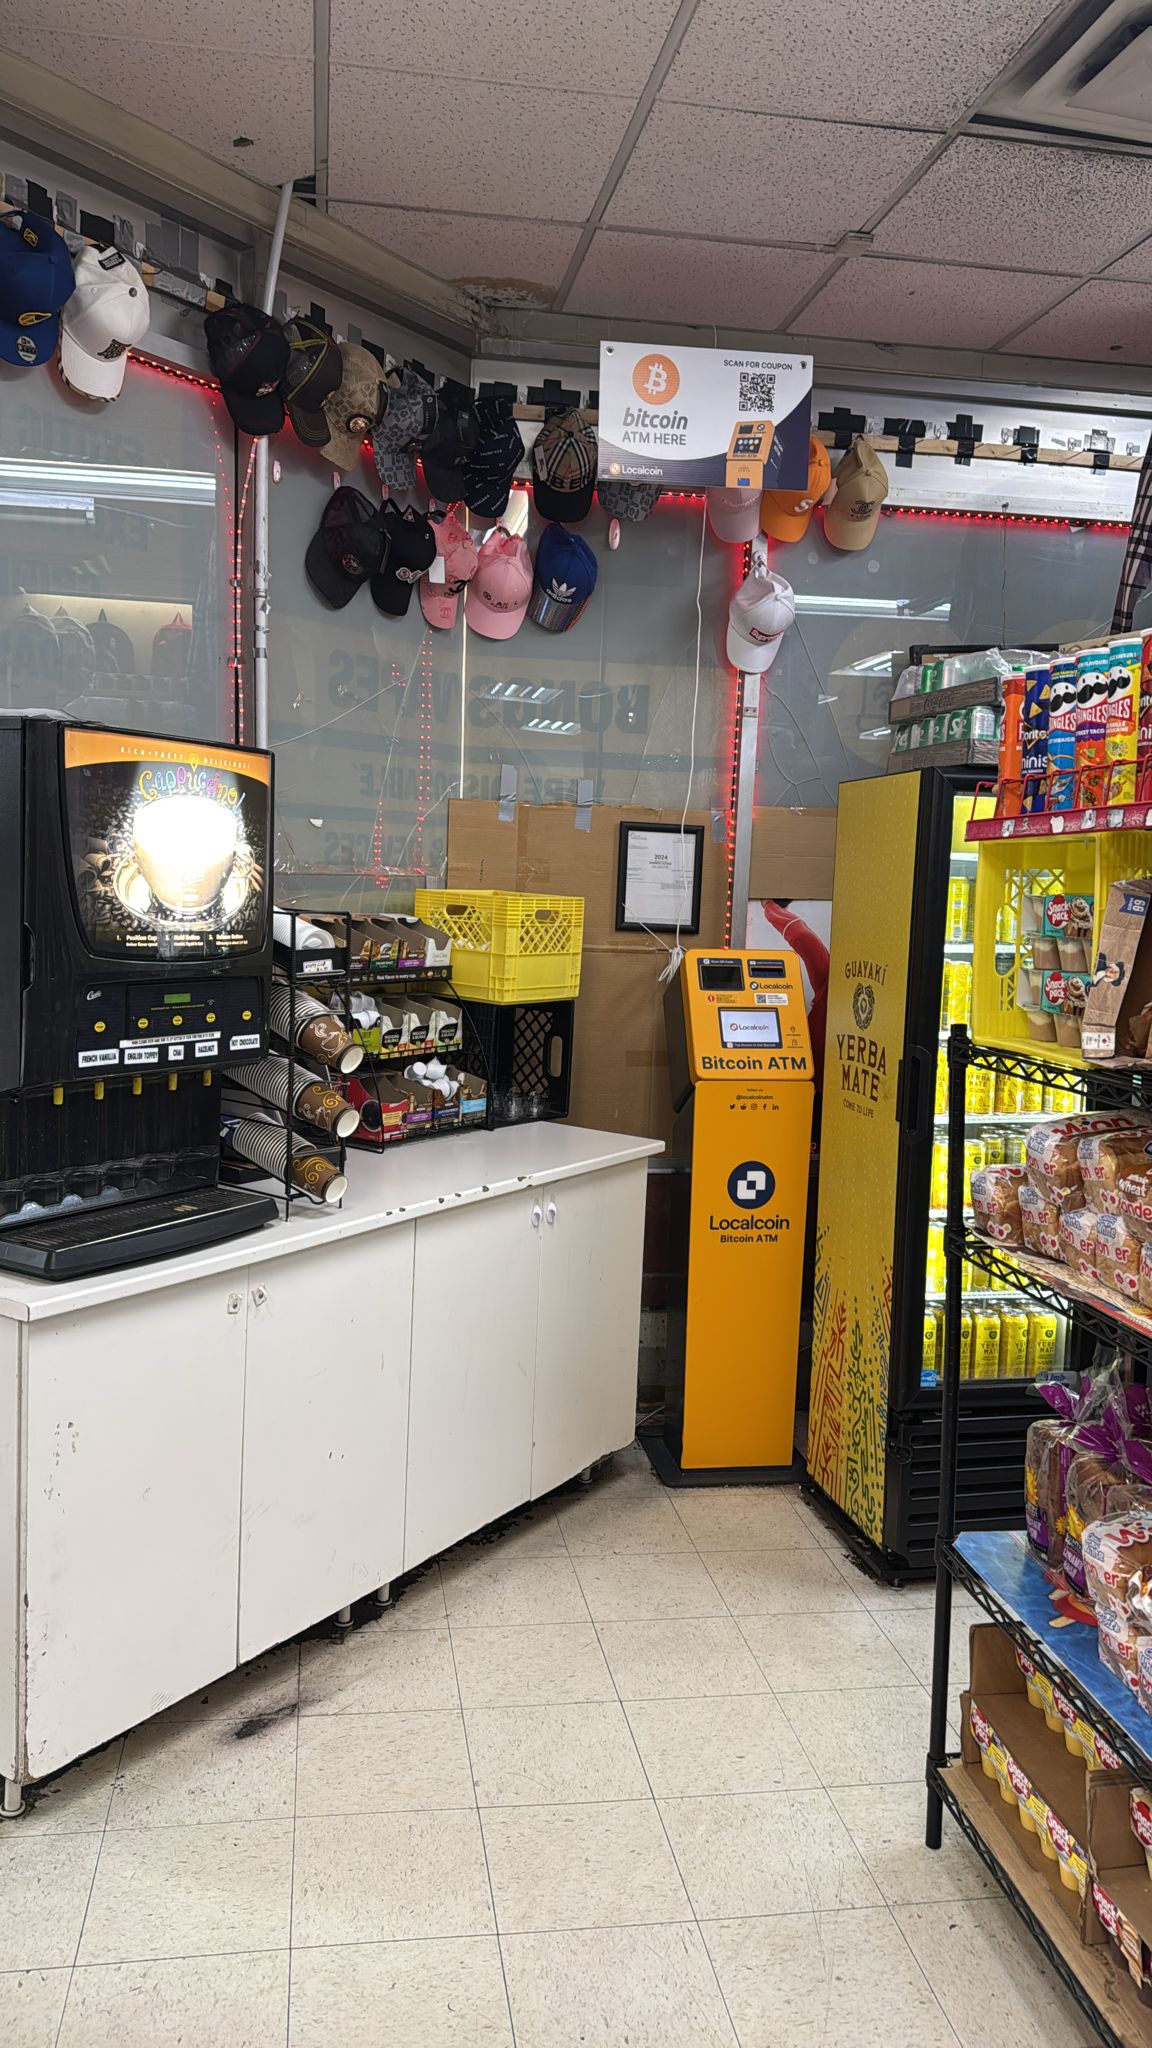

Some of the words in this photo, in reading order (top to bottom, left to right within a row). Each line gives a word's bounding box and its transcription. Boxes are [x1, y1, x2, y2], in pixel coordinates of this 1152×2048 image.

[723, 359, 744, 368] SCAN
[745, 360, 761, 369] FOR
[761, 361, 793, 371] COUPON
[622, 407, 689, 431] bitcoin
[622, 431, 650, 444] ATM
[653, 432, 687, 446] HERE
[621, 464, 663, 476] Localcoin
[546, 588, 573, 603] adidas
[1024, 729, 1049, 741] orito
[1048, 901, 1071, 916] Snack
[1052, 910, 1070, 923] pack
[1045, 977, 1067, 992] Snack
[1049, 986, 1066, 999] pack
[82, 1054, 98, 1063] FRENCH
[127, 1052, 143, 1061] ENGLISH
[836, 1034, 887, 1076] YERBA
[702, 1056, 763, 1070] Bitcoin
[768, 1056, 807, 1071] ATM
[841, 1064, 880, 1102] MATE
[843, 1098, 856, 1111] COME
[856, 1103, 863, 1114] TO
[863, 1105, 874, 1119] LIFE
[1118, 1179, 1147, 1197] Wheat
[1120, 1200, 1152, 1221] onde
[709, 1215, 790, 1231] Localcoin
[720, 1234, 754, 1243] Bitcoin
[756, 1234, 778, 1243] ATM
[1132, 1802, 1152, 1829] Snac
[1137, 1821, 1152, 1841] pac
